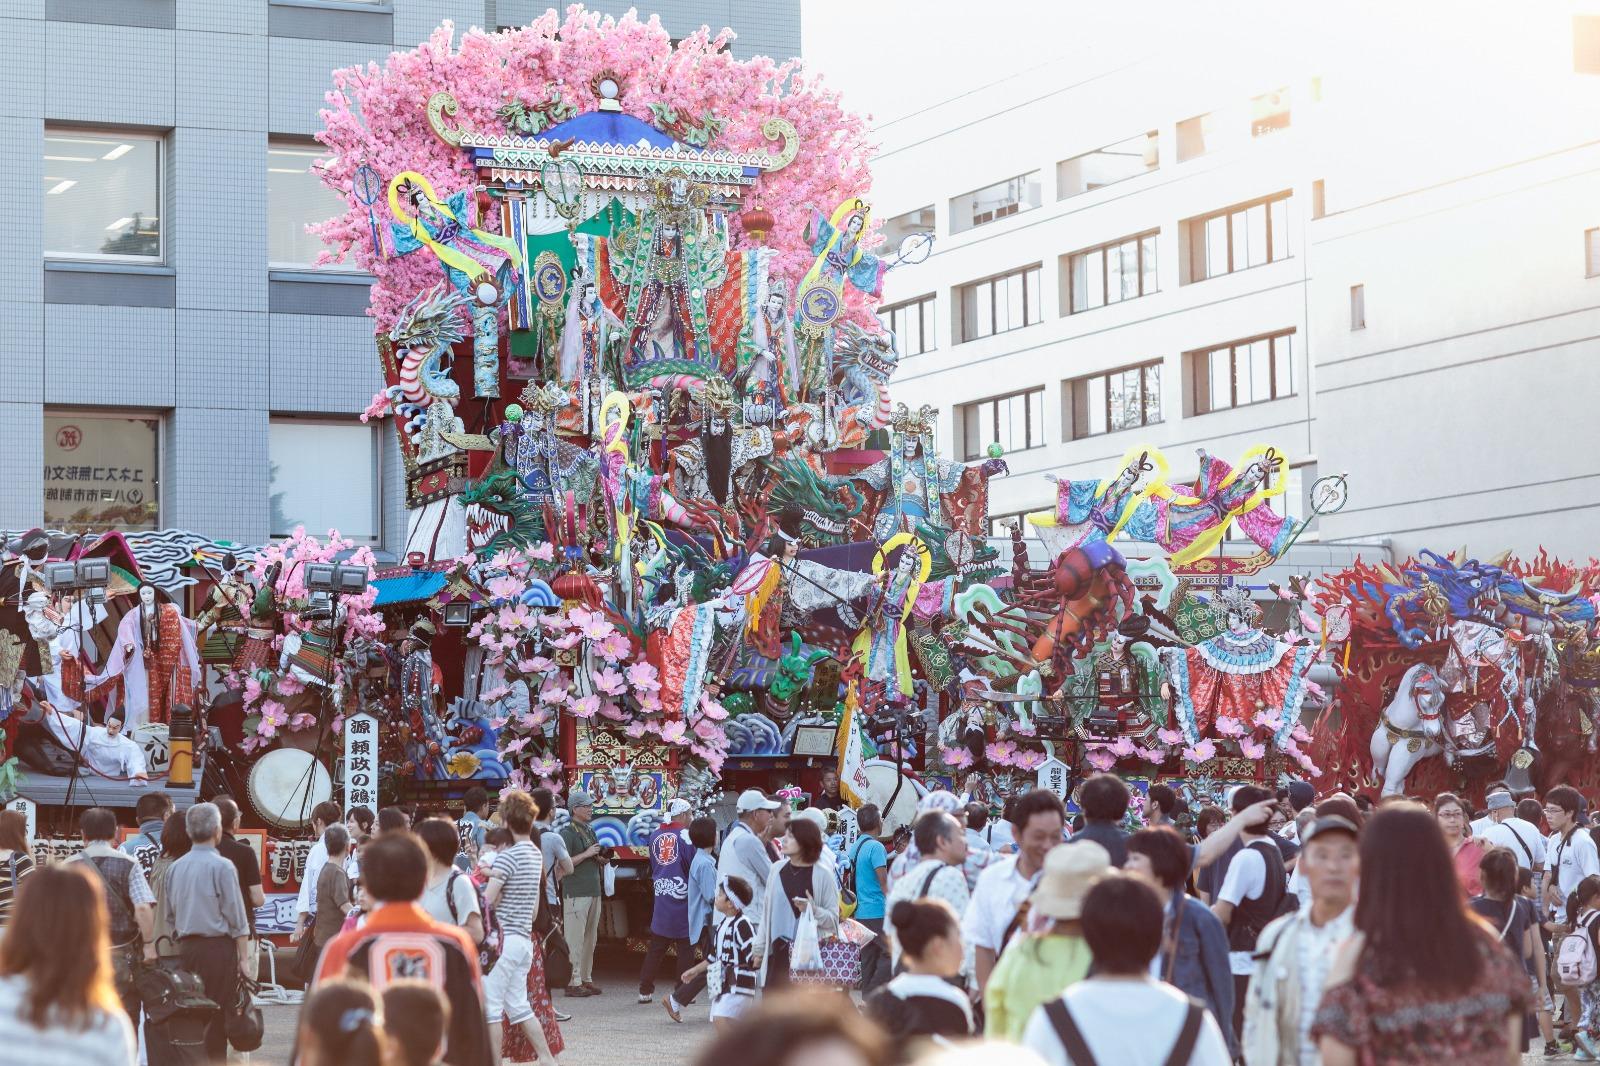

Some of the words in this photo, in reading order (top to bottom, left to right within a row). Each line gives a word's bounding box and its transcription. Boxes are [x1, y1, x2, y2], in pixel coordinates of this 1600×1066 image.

[351, 719, 371, 808] 源頼政の鵺
